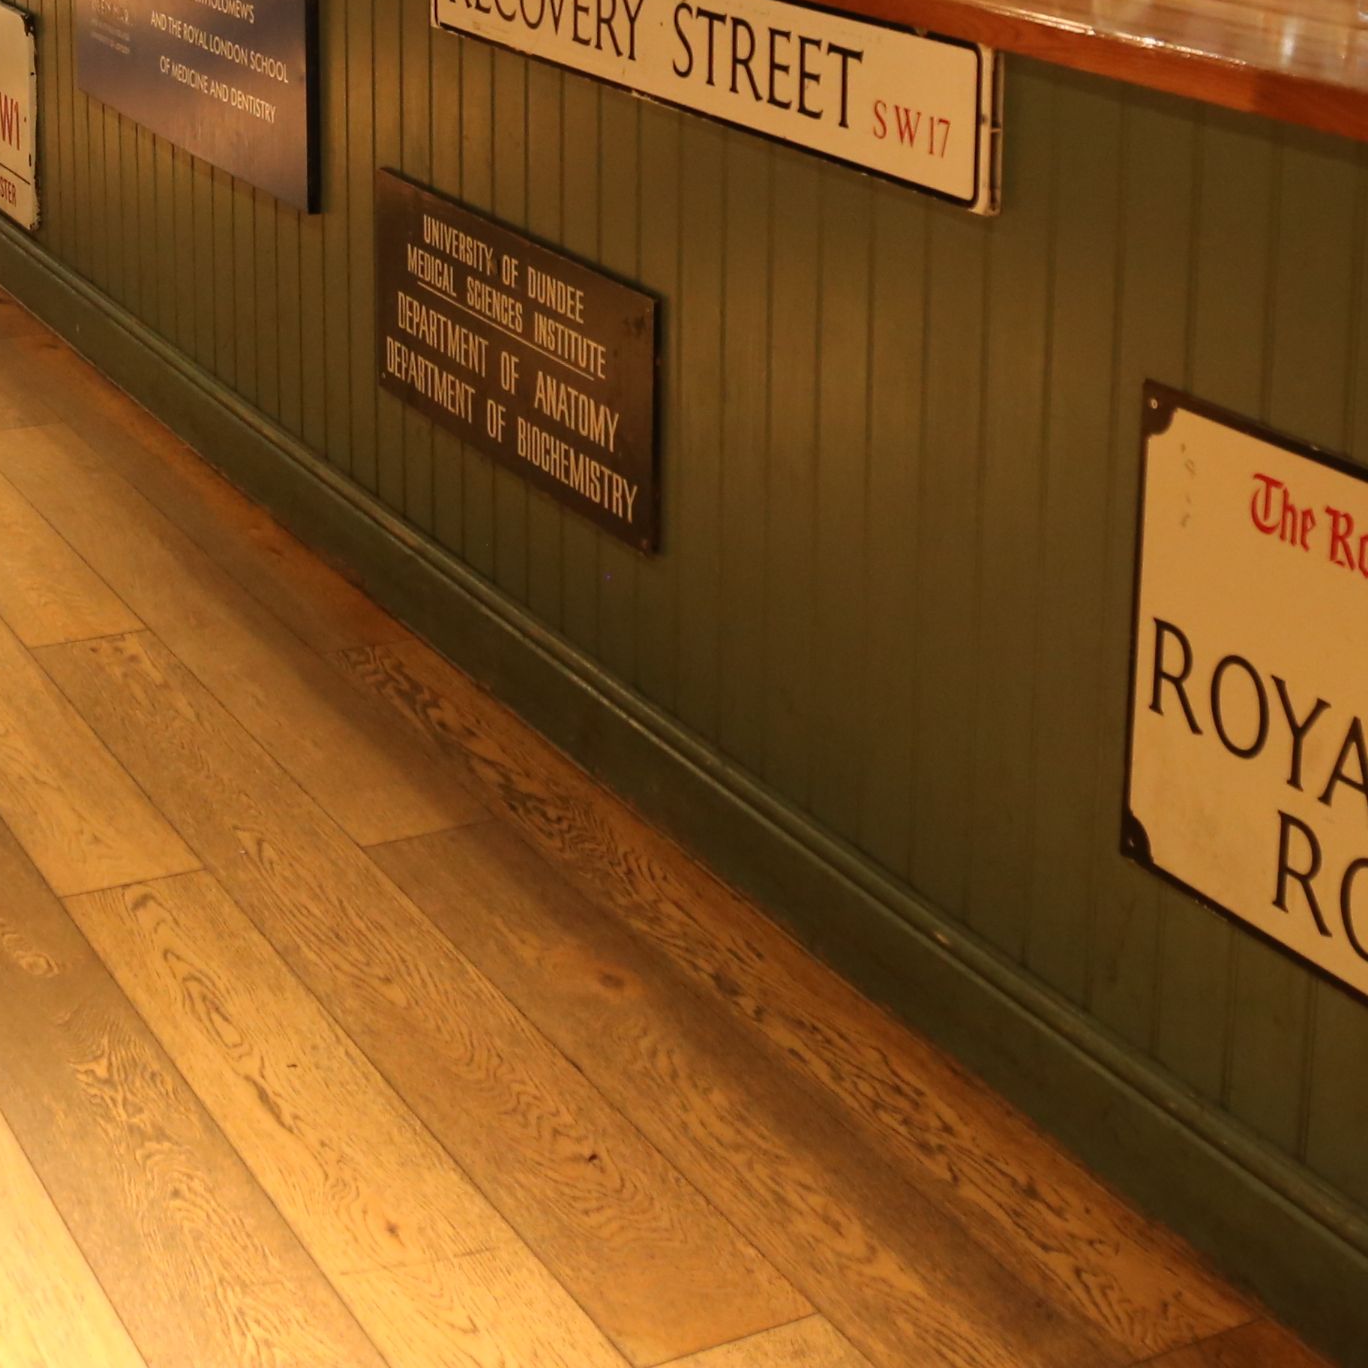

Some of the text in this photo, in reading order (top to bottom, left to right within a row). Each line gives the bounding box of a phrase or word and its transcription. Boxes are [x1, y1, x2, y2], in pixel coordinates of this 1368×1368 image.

[150, 10, 289, 84] AND THE ROYAL LONDON SCHOOL
[159, 55, 277, 125] OF MEDICINE AND DENTISTRY
[672, 2, 864, 129] STREET
[407, 243, 607, 381] MEDICAL SCIENCES INSTITUTE
[423, 213, 584, 324] UNIVERSITY OF DUNDEE
[386, 335, 638, 524] DEPARTMENT OF BIOCHEMISTRY
[397, 290, 620, 453] DEPARTMENT OF ANATOMY
[1250, 472, 1316, 552] The
